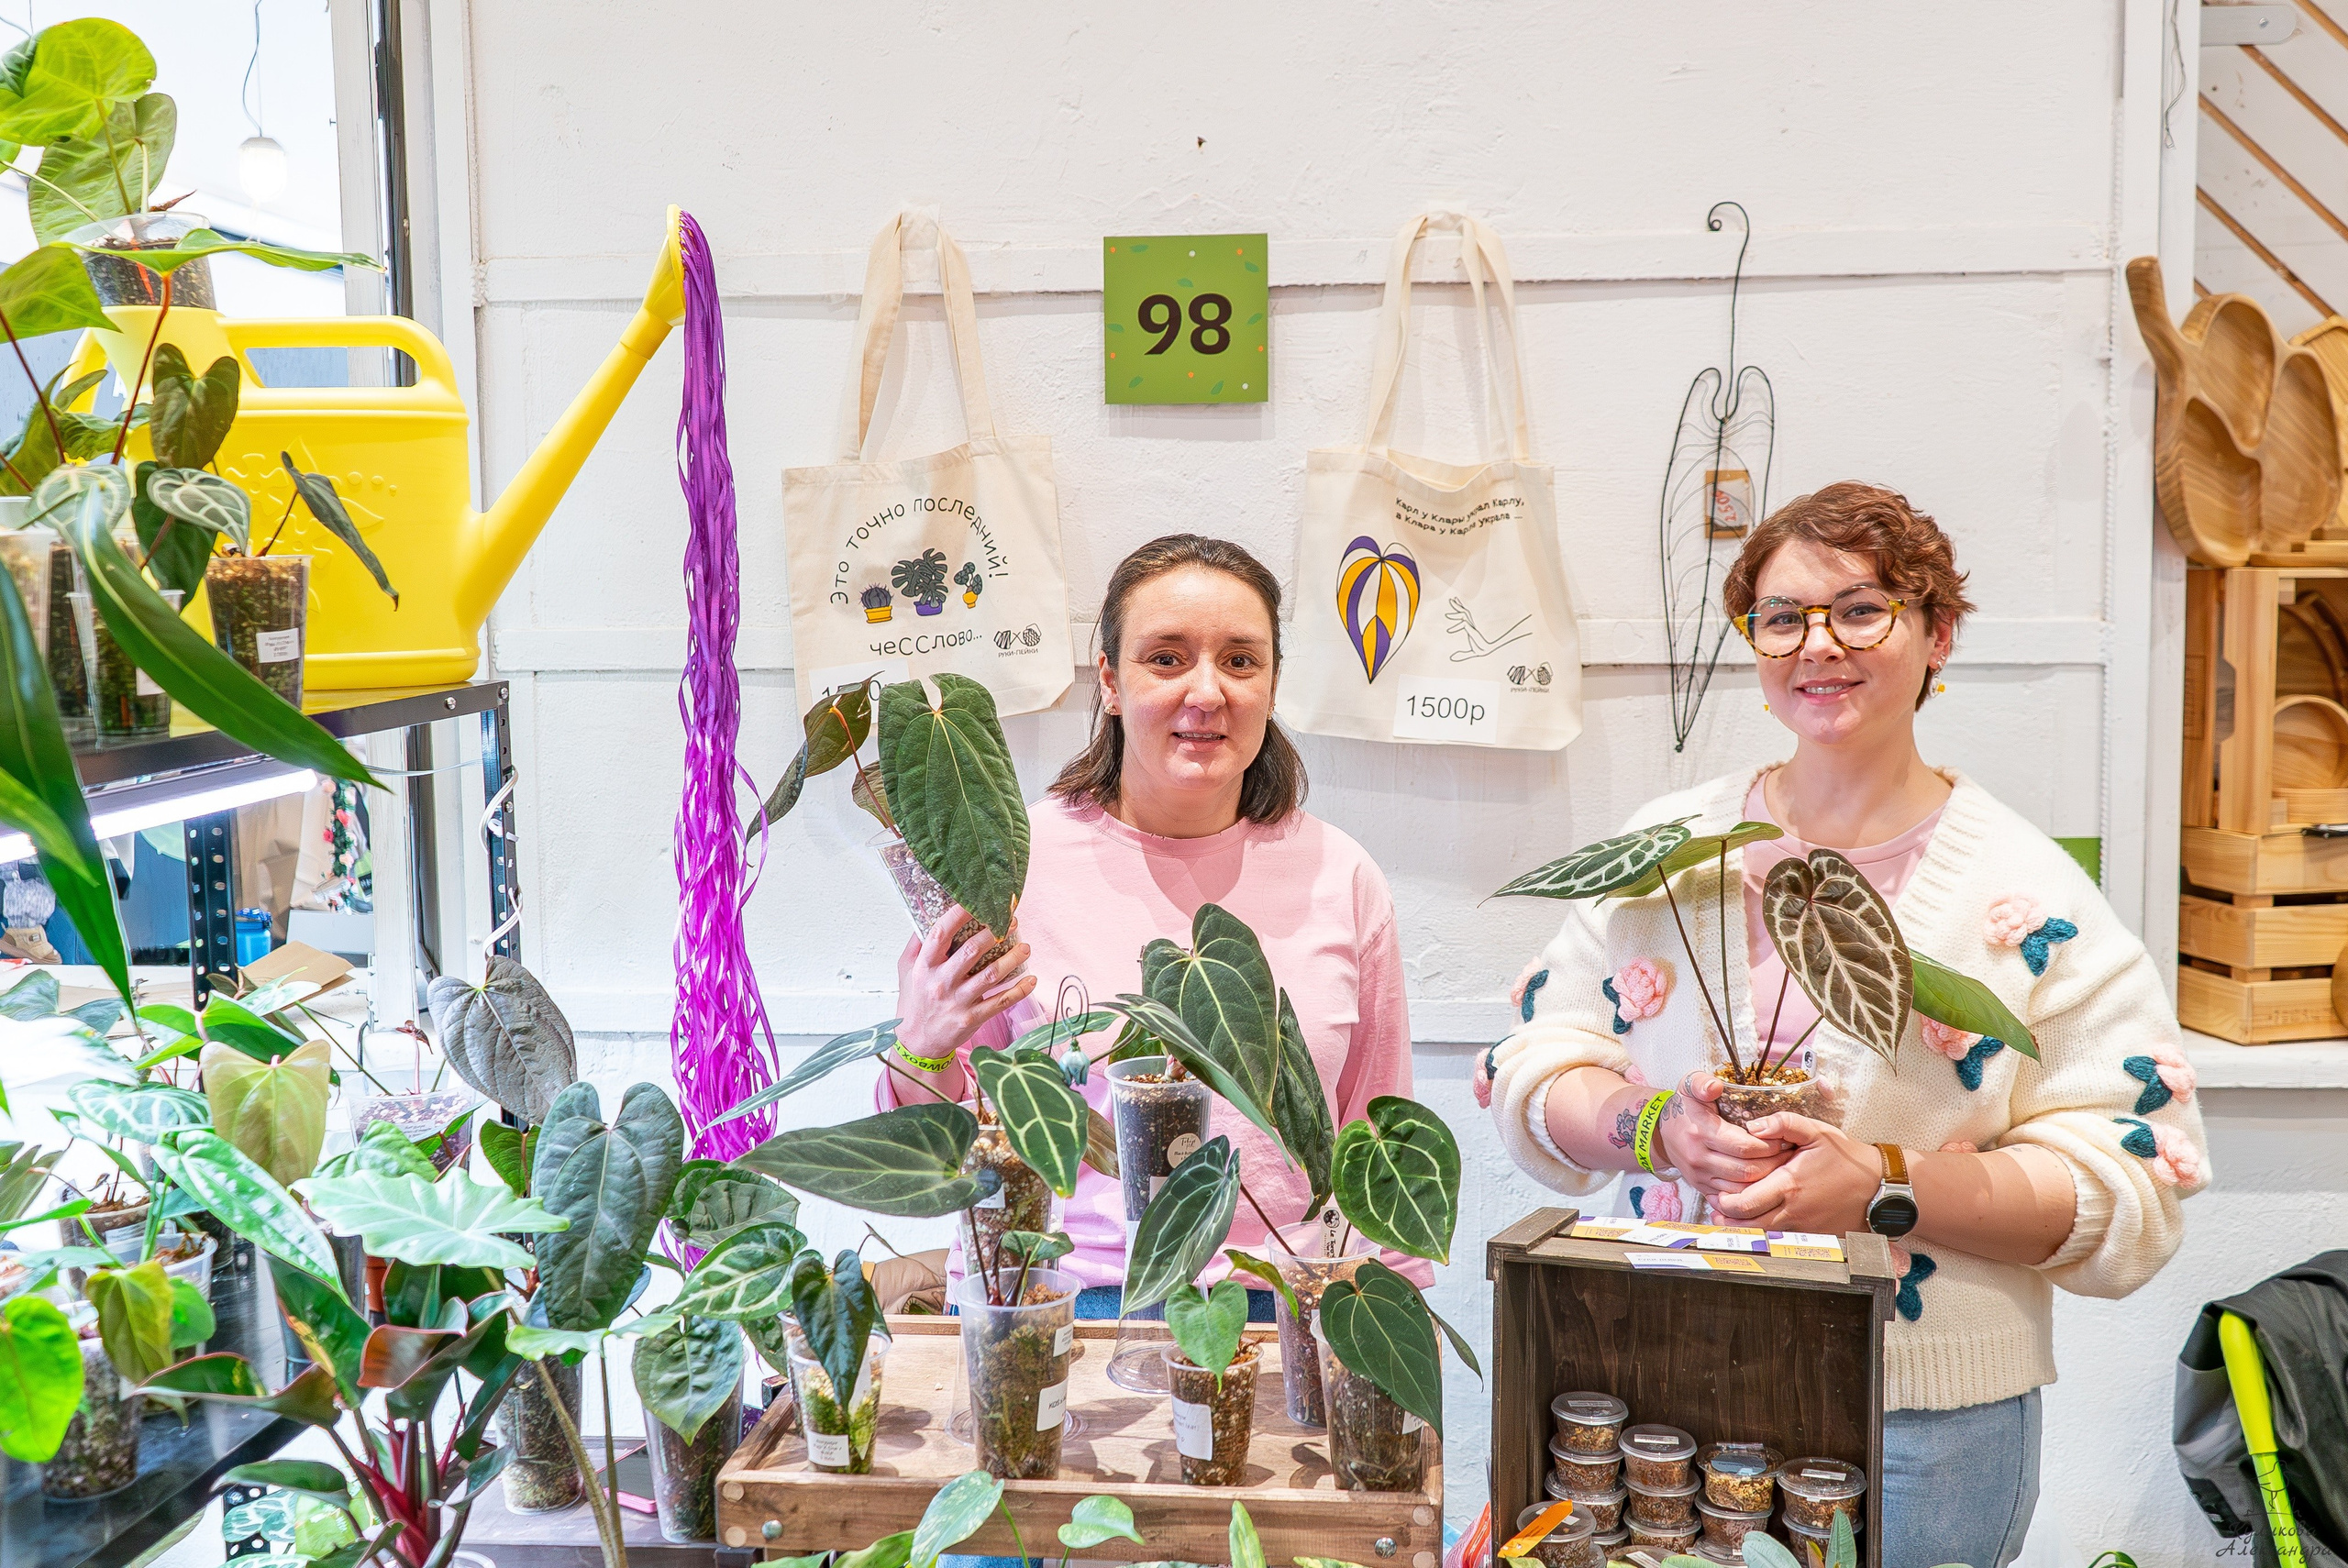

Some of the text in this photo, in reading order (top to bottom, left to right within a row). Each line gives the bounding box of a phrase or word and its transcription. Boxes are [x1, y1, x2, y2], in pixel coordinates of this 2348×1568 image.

[1138, 293, 1233, 355] 98
[1395, 497, 1419, 515] Карл
[1421, 511, 1429, 519] у
[1431, 513, 1465, 525] Клары
[1467, 502, 1490, 522] украл
[1395, 512, 1402, 520] а
[1404, 514, 1436, 532] Клара
[1478, 512, 1511, 527] украла
[829, 496, 1009, 605] Это точно последний!
[1406, 695, 1486, 725] 1500р
[1638, 1096, 1663, 1152] MARKET
